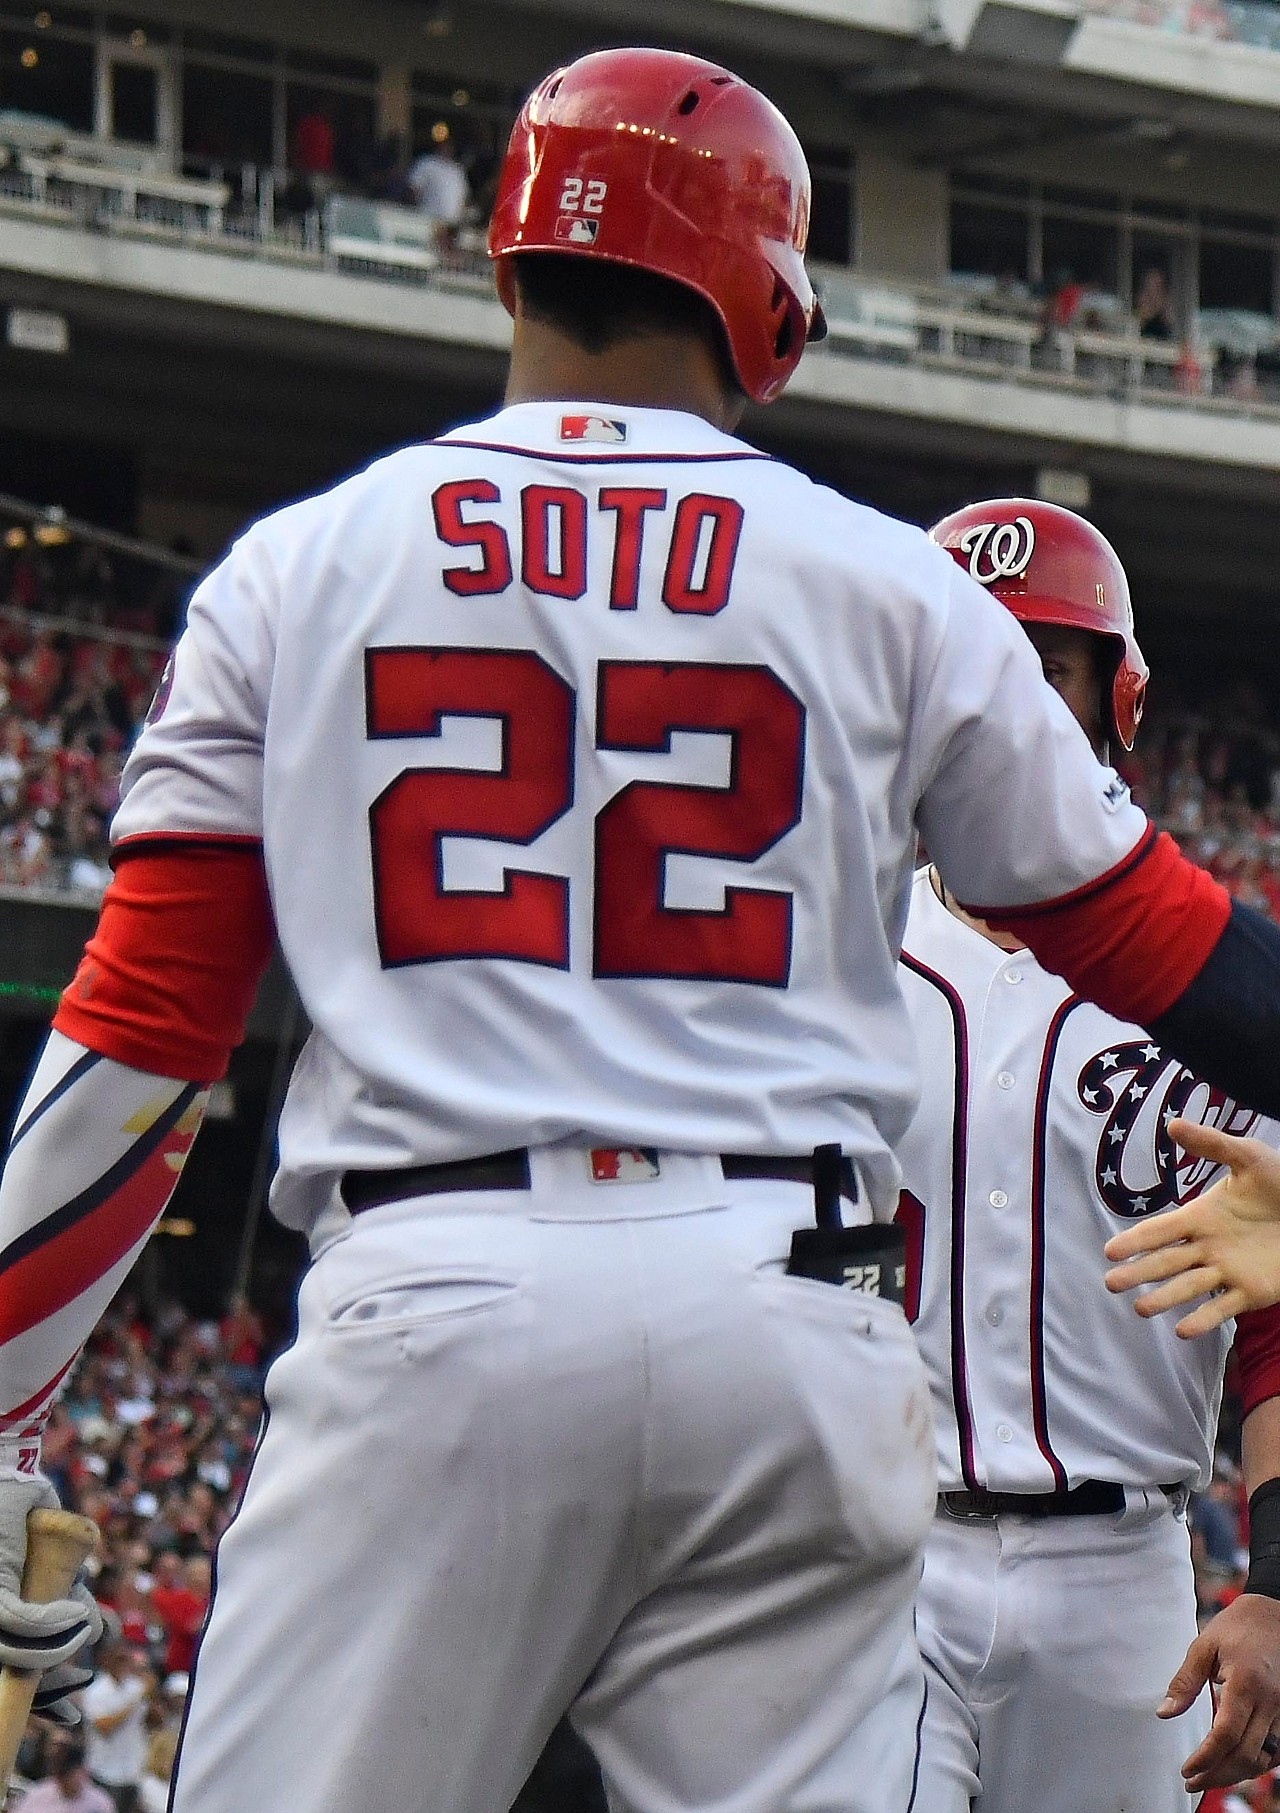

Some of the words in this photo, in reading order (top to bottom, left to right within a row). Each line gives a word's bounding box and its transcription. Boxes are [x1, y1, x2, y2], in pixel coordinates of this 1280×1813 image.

[559, 177, 608, 214] 22
[431, 479, 745, 616] SOTO
[364, 646, 806, 989] 22
